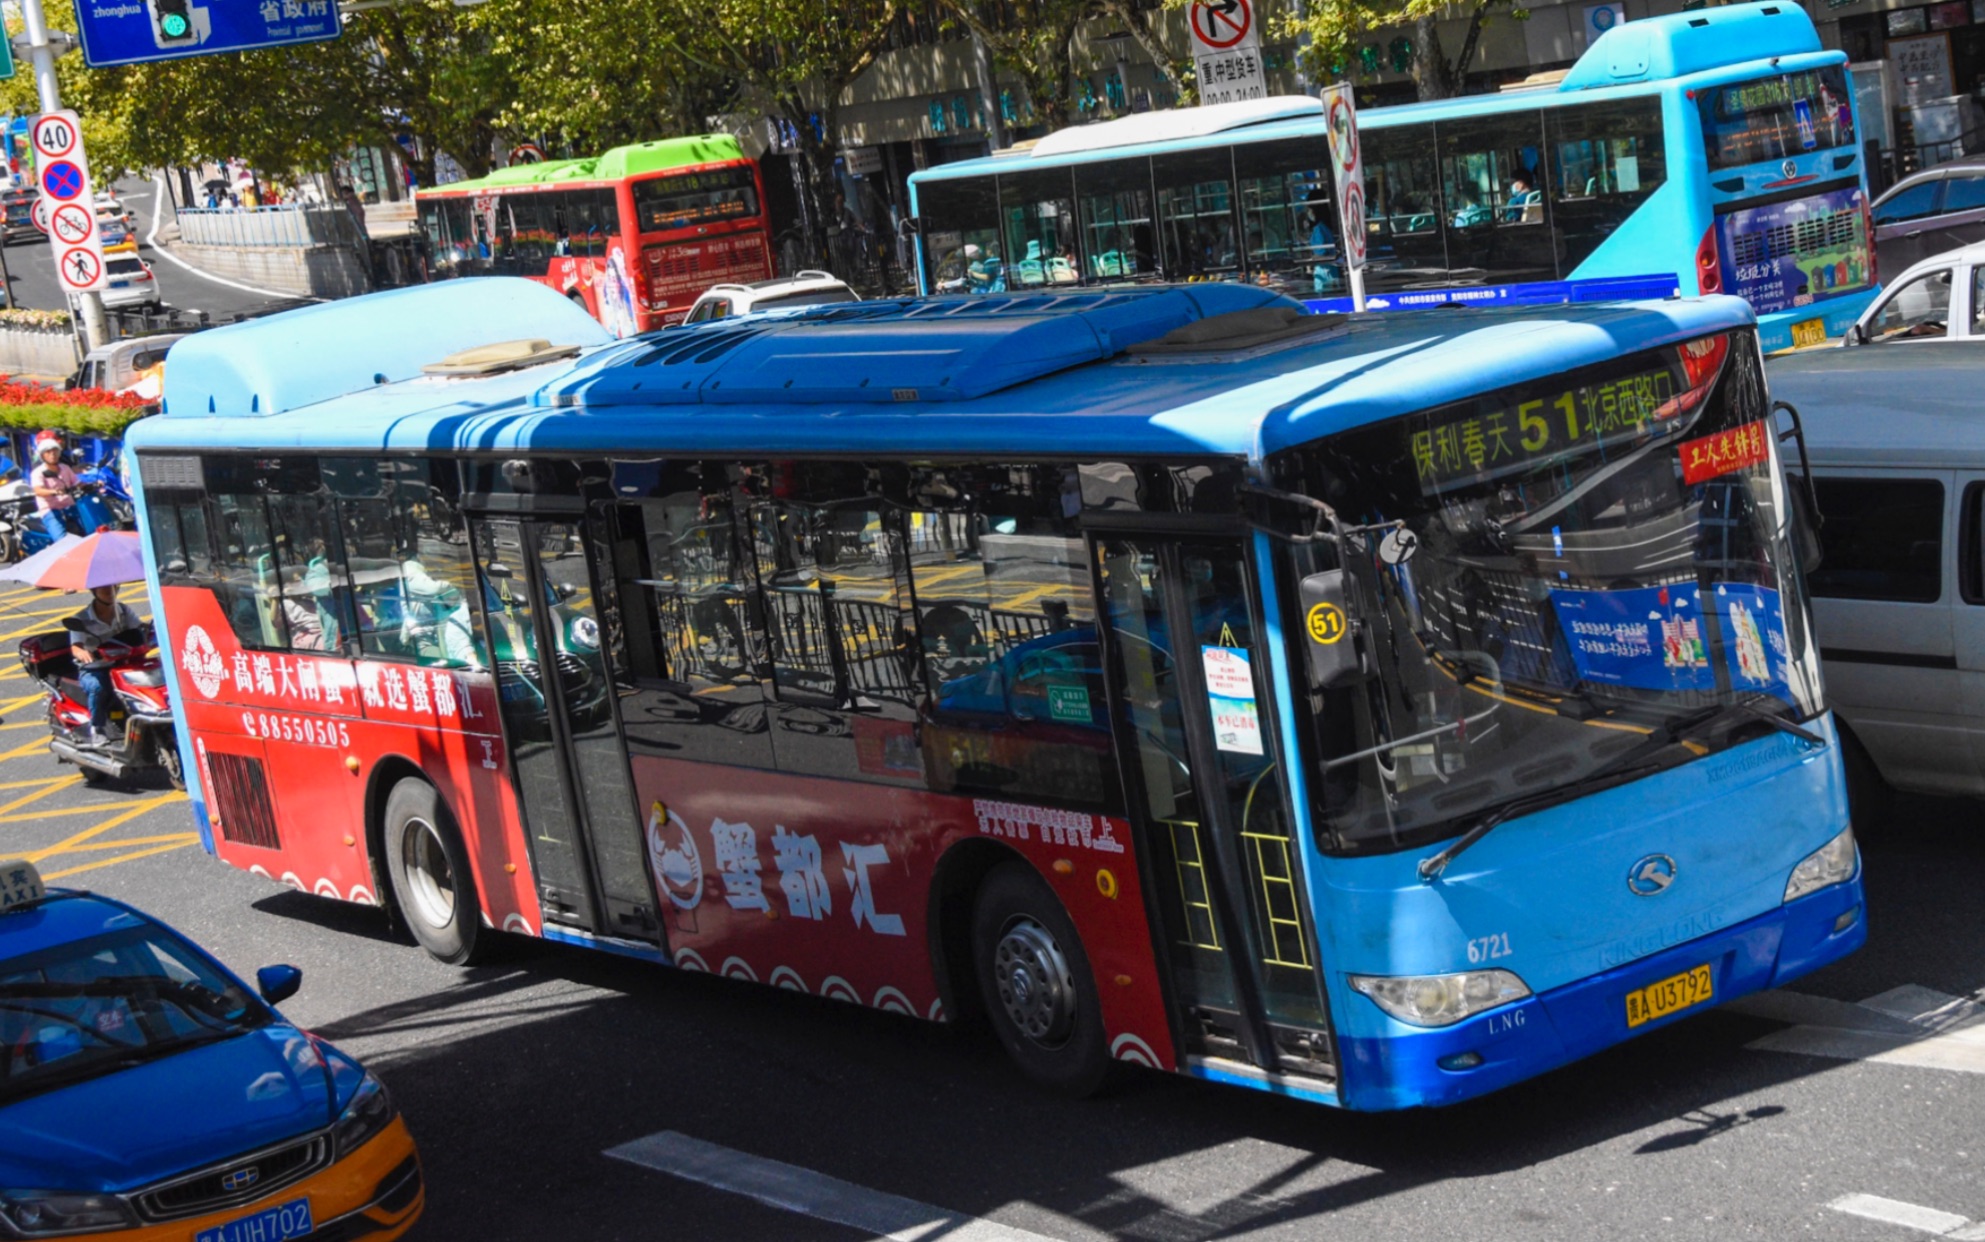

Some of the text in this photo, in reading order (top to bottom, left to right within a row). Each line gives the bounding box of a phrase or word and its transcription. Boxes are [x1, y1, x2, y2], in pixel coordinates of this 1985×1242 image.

[259, 0, 328, 22] 省政府
[43, 125, 68, 149] 40
[1735, 259, 1781, 281] 垃圾分类
[1412, 371, 1674, 481] 保利春天 51 北京西路口
[1690, 425, 1761, 468] 工人先锋号
[1312, 613, 1339, 634] 51
[259, 713, 350, 748] 88550505
[710, 817, 907, 937] 蟹都汇
[1467, 932, 1513, 964] 6721
[1489, 1009, 1526, 1035] LNG
